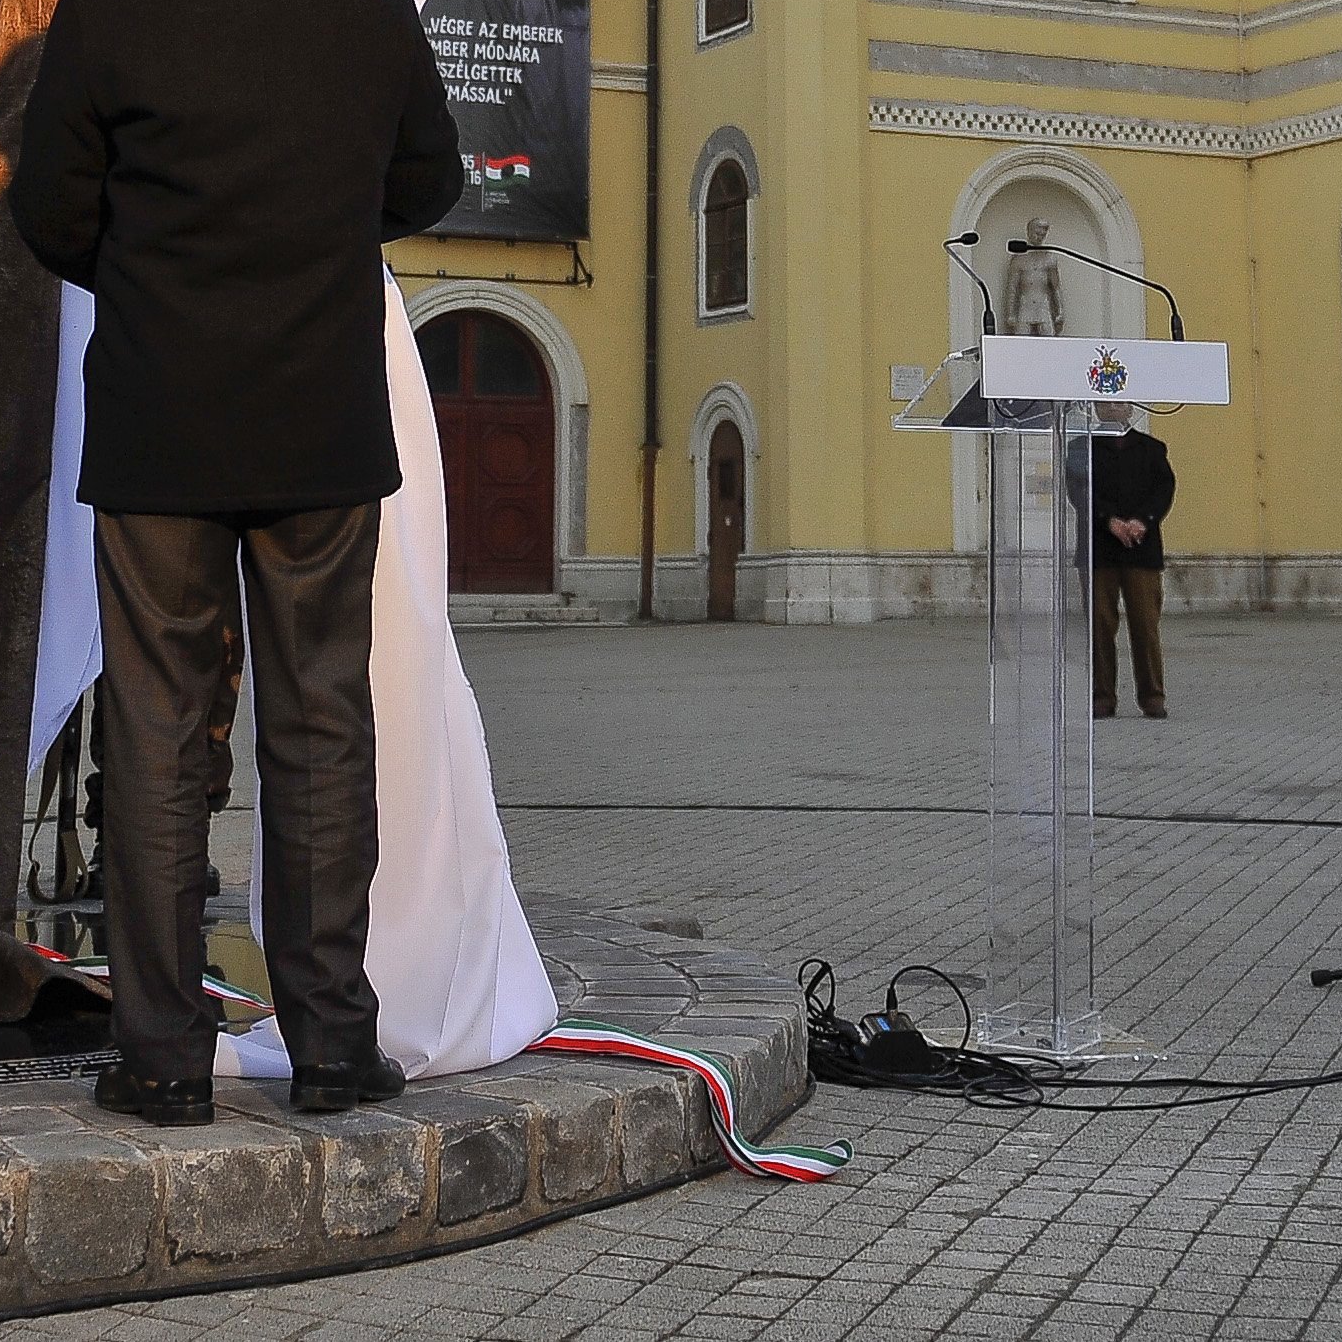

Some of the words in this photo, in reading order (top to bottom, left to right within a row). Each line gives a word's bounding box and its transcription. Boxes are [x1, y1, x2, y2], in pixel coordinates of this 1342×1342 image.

[479, 22, 498, 39] AZ
[503, 24, 564, 44] EMBEREK
[429, 39, 468, 59] MBER
[474, 40, 541, 65] MÓDJÁRA
[435, 59, 523, 85] SZÉLGETTEK
